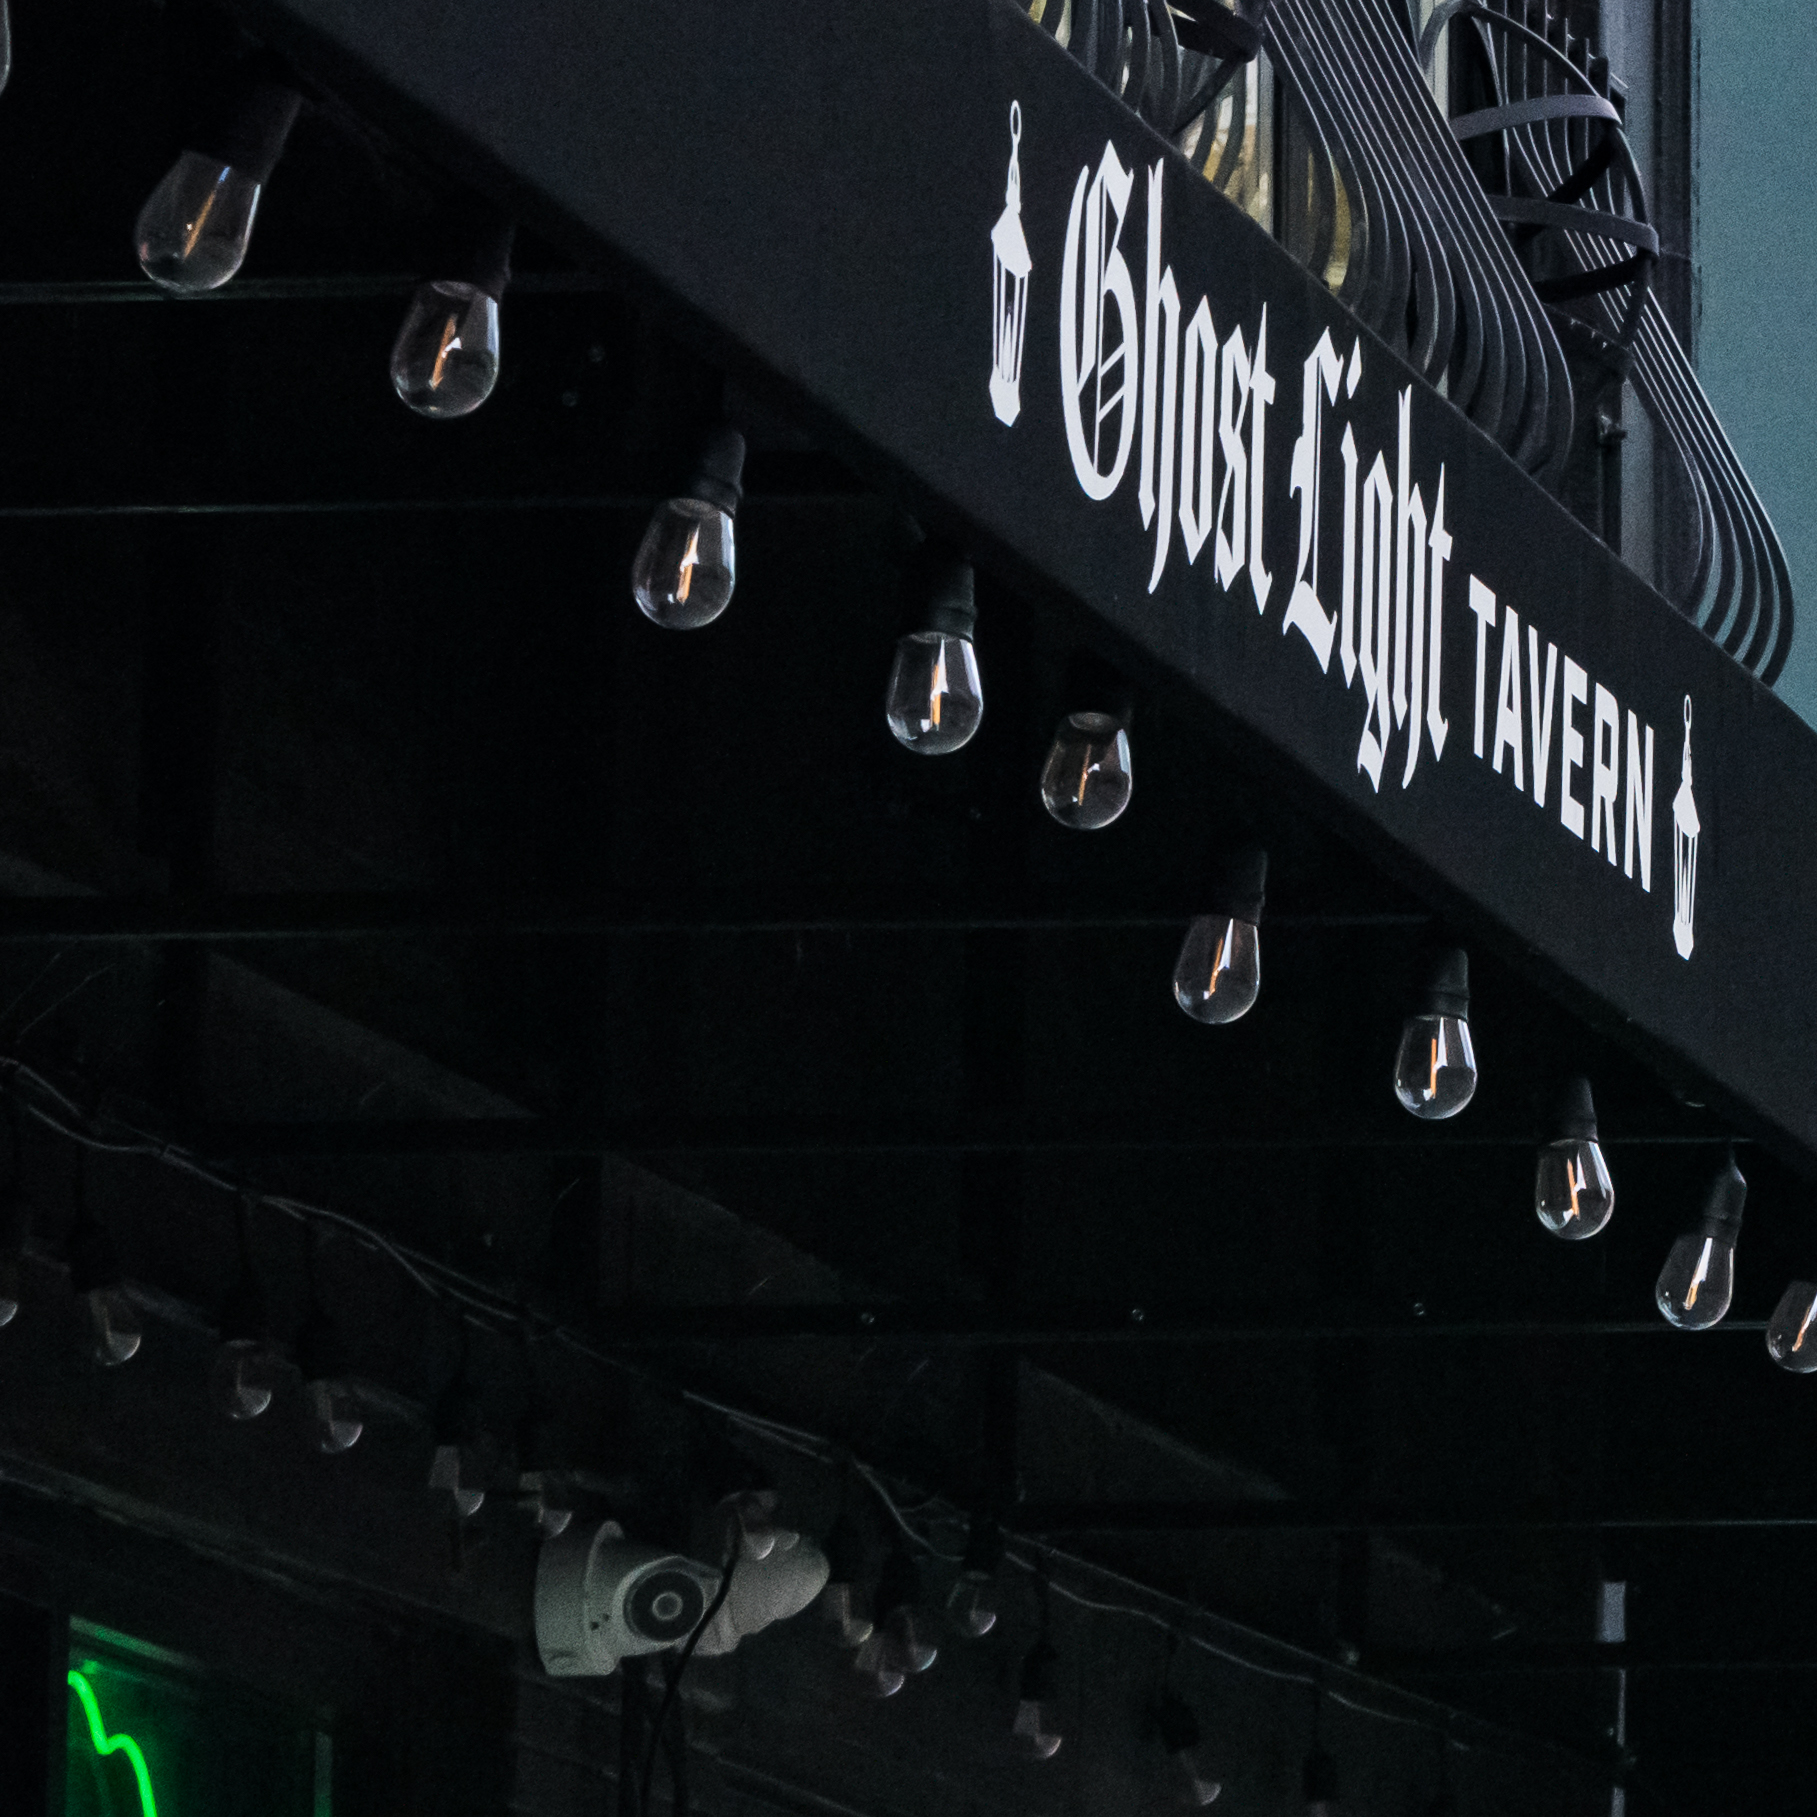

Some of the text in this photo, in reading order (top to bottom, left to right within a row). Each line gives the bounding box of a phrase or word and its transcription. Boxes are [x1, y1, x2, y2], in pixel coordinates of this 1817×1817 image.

[1058, 138, 1655, 894] Ghost Light TAVERN
